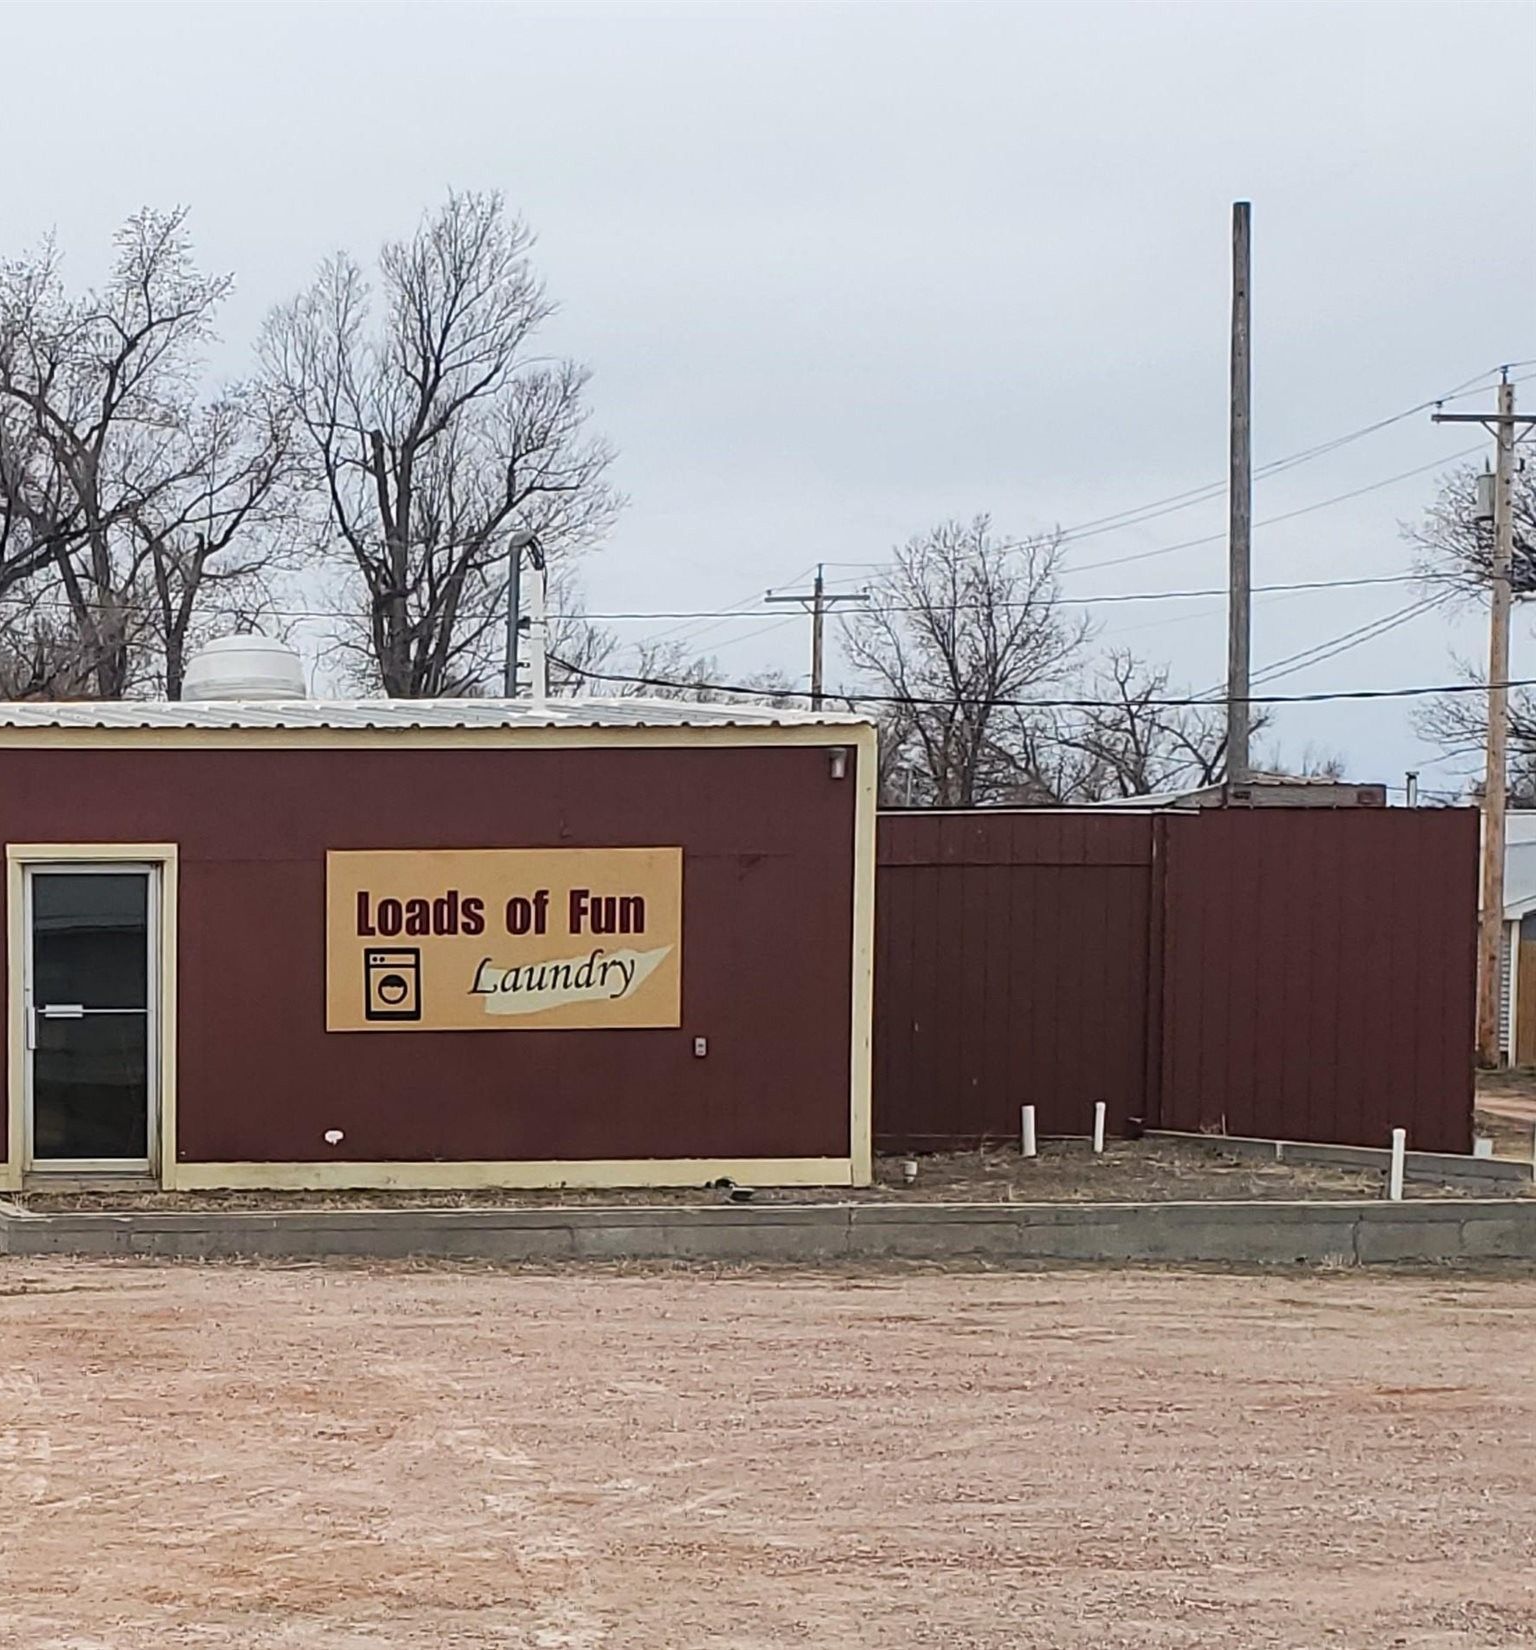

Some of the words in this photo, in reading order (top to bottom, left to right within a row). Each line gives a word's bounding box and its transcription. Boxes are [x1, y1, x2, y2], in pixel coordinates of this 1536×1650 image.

[356, 890, 486, 937] Loads
[506, 889, 549, 936] of
[569, 889, 646, 935] Fun
[467, 948, 636, 999] Laundry
